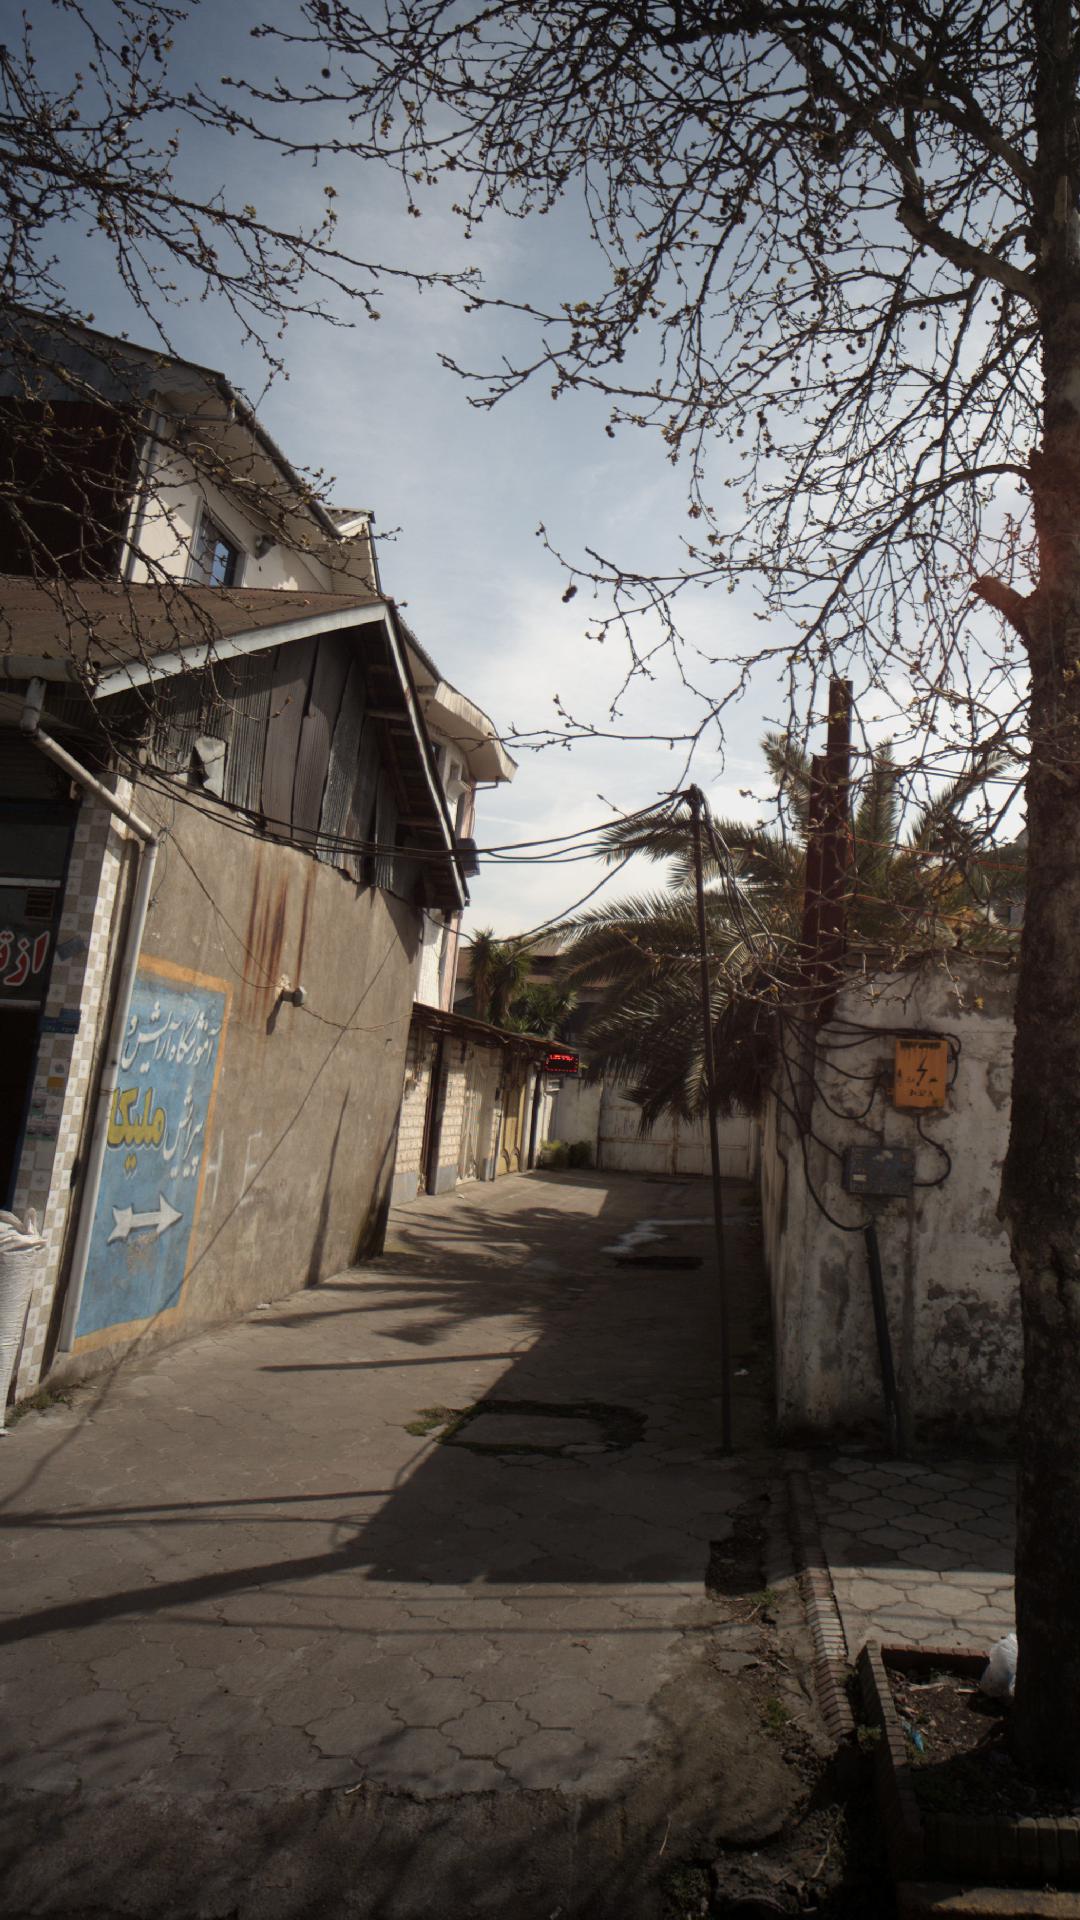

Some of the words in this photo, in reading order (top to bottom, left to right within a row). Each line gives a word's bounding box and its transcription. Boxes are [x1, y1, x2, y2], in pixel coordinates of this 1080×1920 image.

[121, 1000, 180, 1072] آرایش
[167, 1005, 222, 1066] آموزشگاه
[106, 1085, 167, 1174] ملیکا
[162, 1083, 204, 1177] پیرایش
